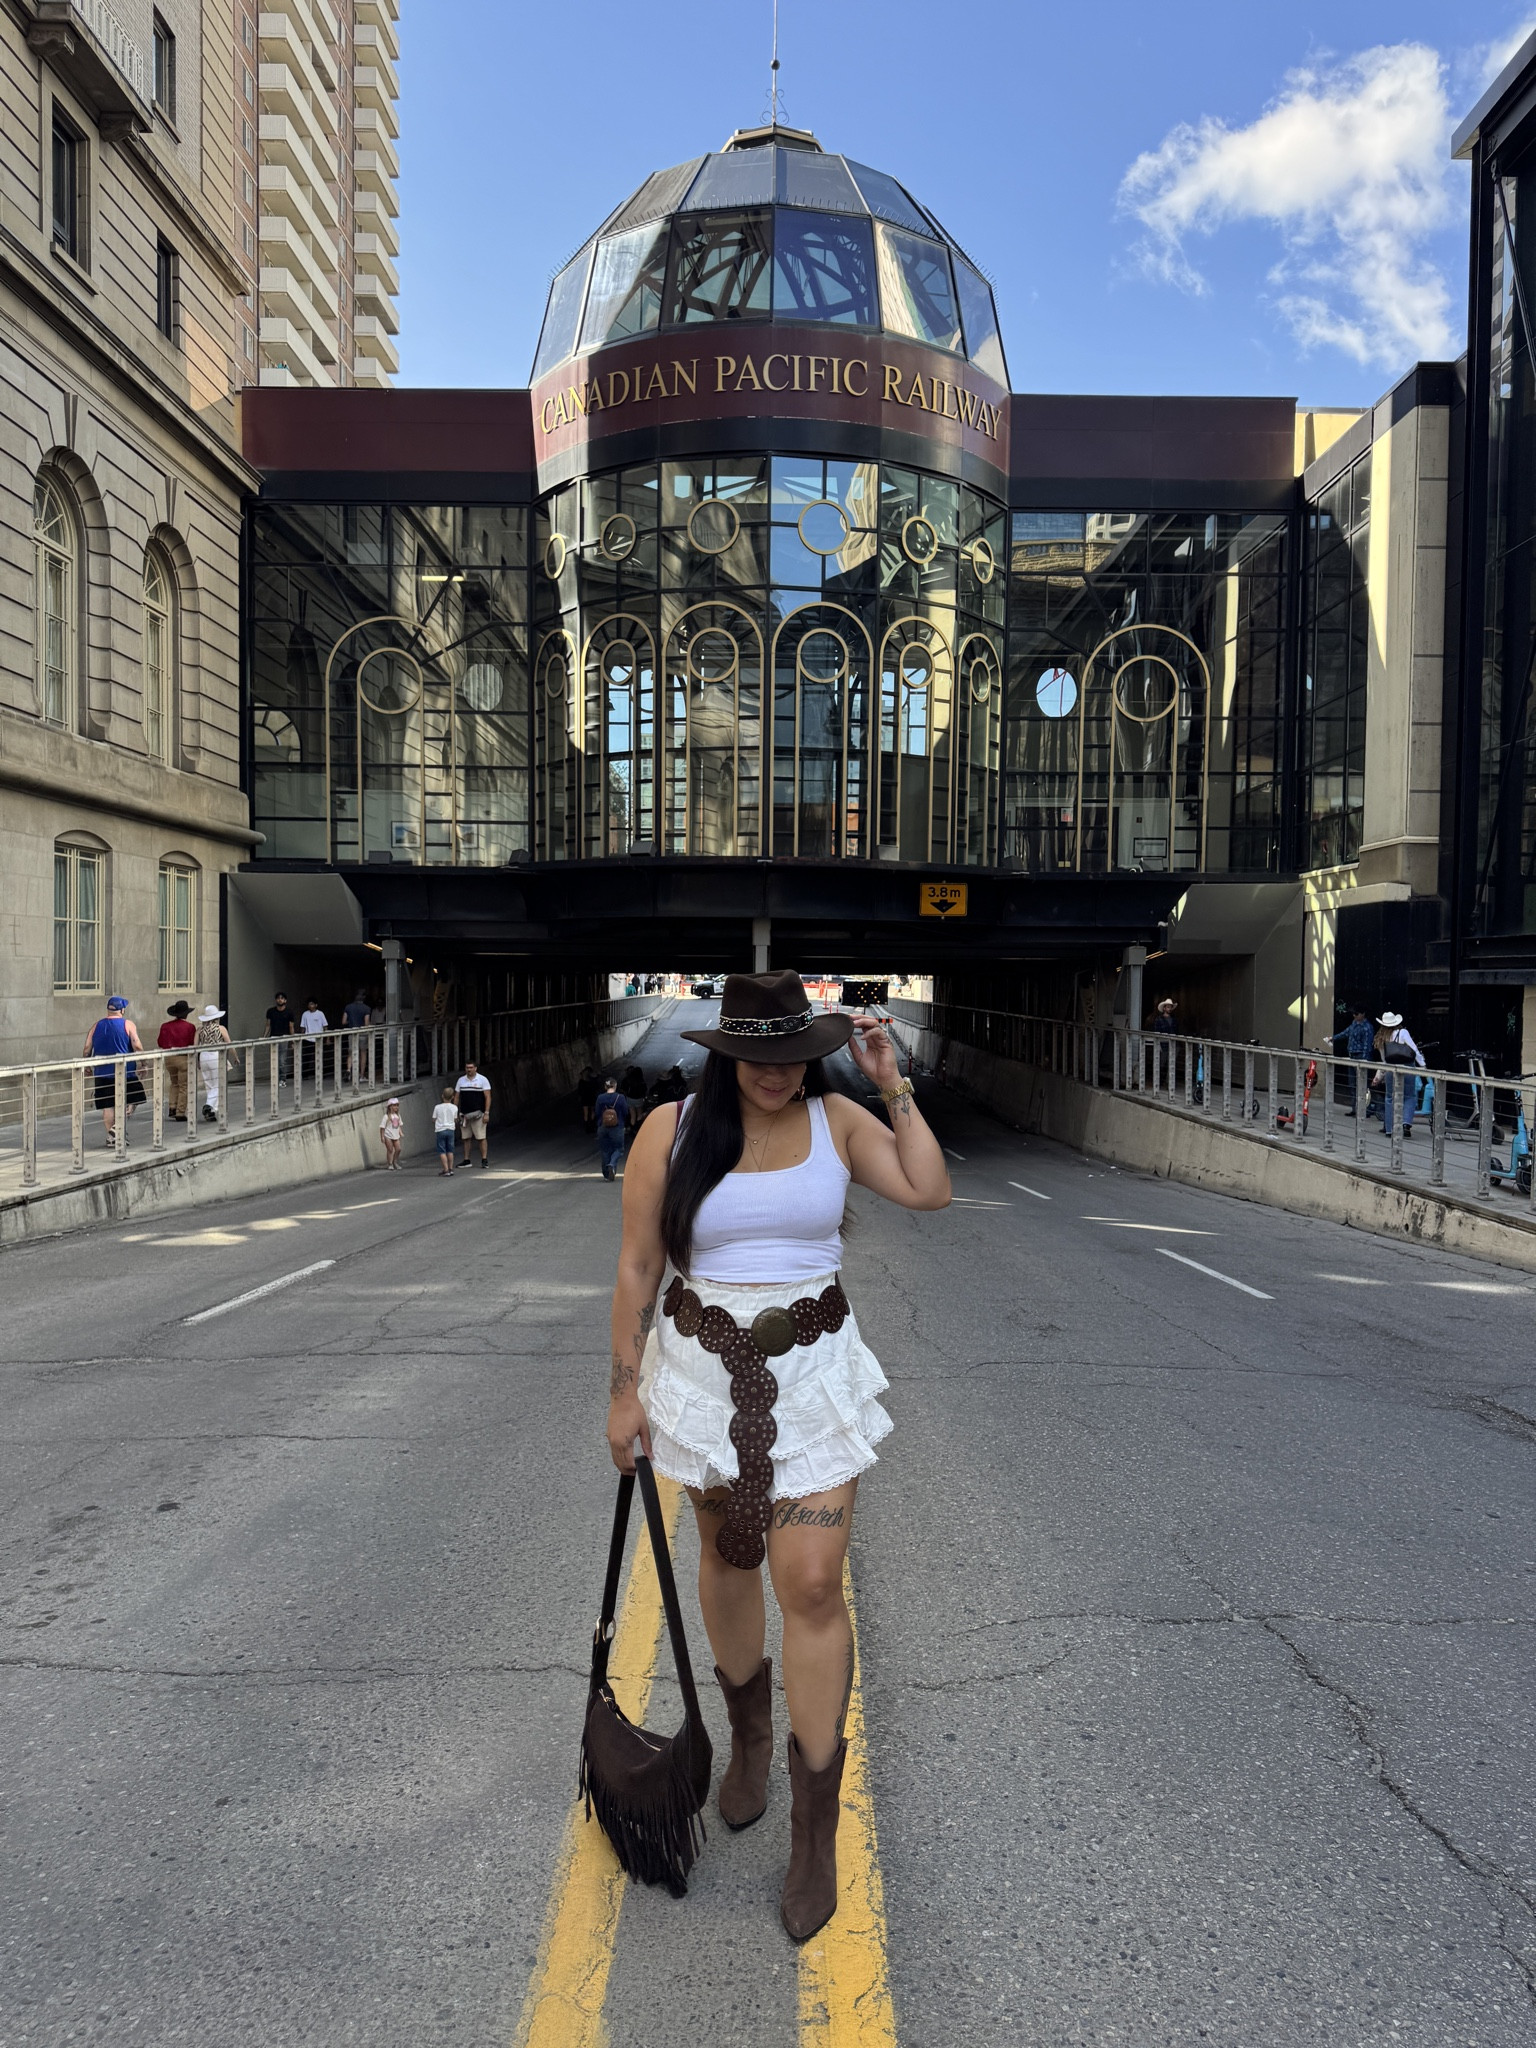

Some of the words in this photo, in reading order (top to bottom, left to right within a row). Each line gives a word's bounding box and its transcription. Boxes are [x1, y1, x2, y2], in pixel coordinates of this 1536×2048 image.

[540, 358, 701, 435] CANADIAN
[714, 353, 868, 397] PACIFIC
[881, 364, 1003, 440] RAILWAY
[774, 1502, 845, 1529] Isaiah
